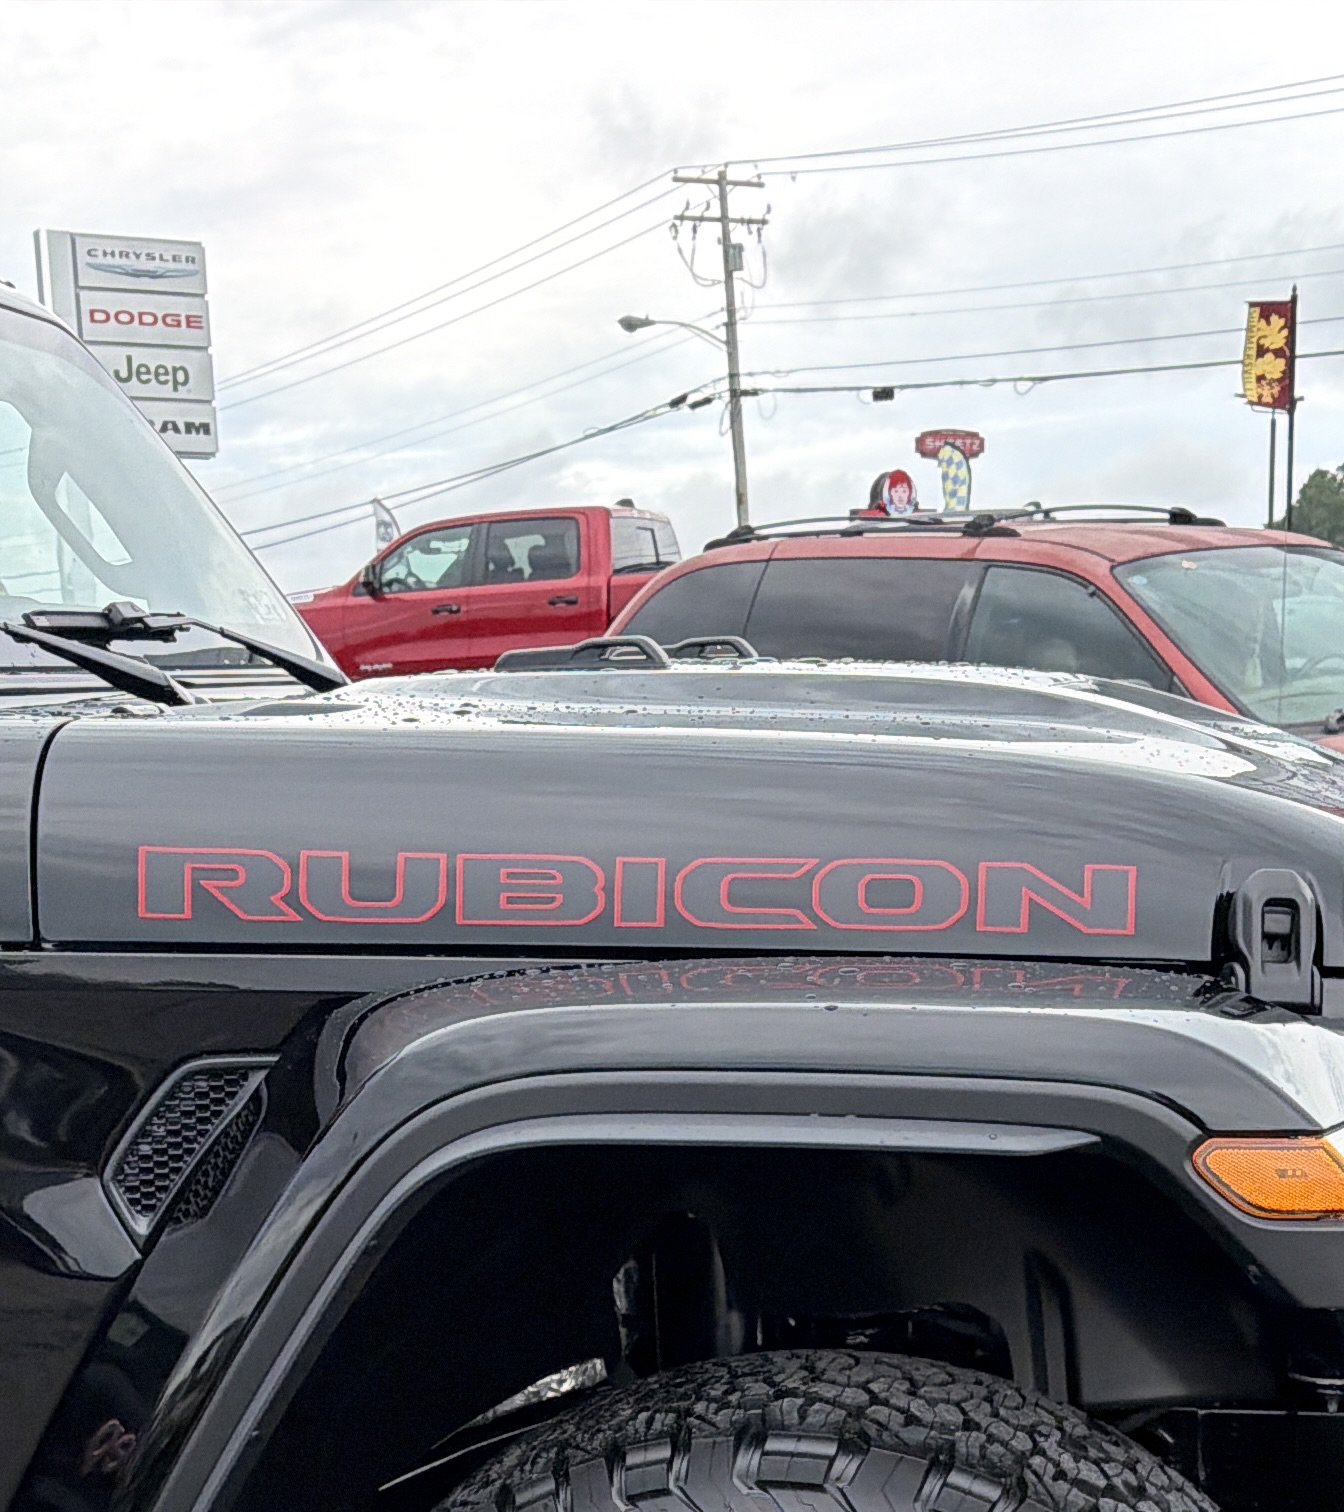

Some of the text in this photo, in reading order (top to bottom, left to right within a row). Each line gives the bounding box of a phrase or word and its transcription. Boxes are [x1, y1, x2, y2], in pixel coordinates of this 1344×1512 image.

[86, 247, 197, 265] CHRYSLER
[89, 308, 204, 330] DODGE
[113, 354, 190, 392] Jeep
[137, 845, 1138, 936] RUBICON
